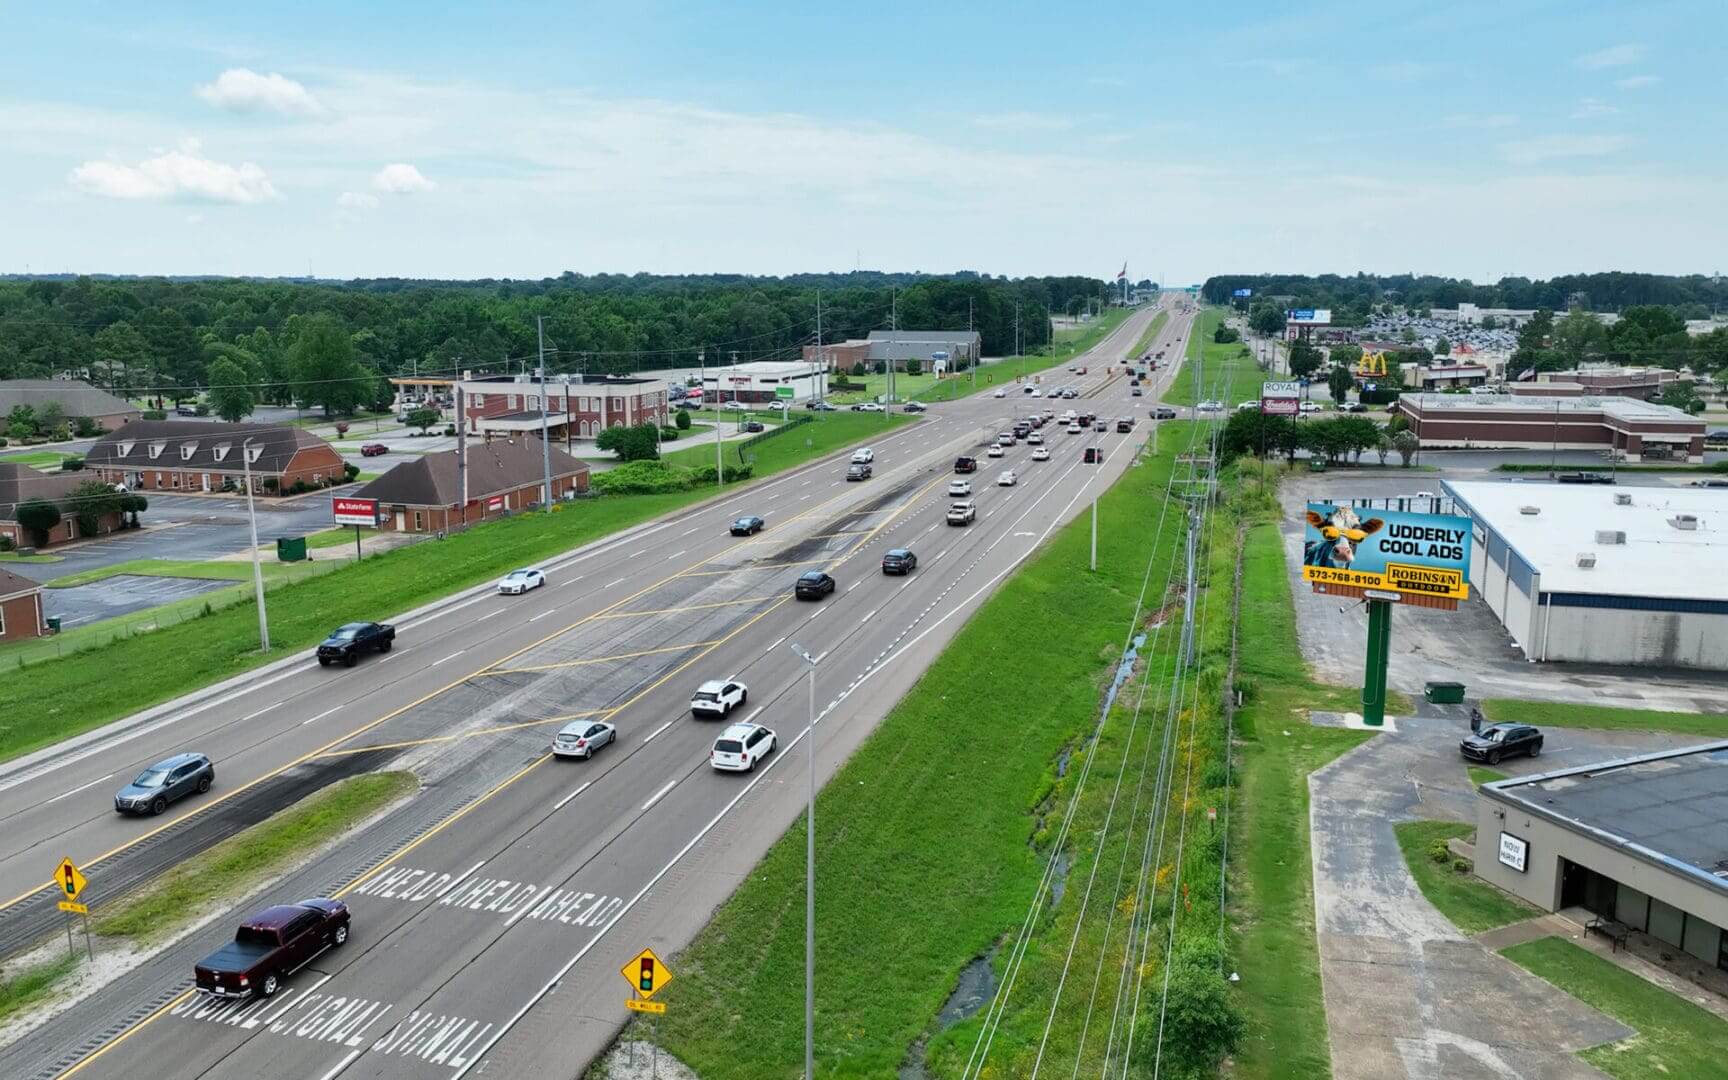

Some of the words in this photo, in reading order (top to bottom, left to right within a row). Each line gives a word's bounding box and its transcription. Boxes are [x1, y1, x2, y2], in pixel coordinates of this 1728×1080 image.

[1265, 383, 1297, 392] ROYAL
[1389, 524, 1465, 544] UDDERLY
[1379, 539, 1423, 556] COOL
[1427, 544, 1463, 560] ADS
[1309, 569, 1381, 586] 573-768-8100
[1392, 569, 1457, 585] ROBINSON
[1400, 582, 1446, 592] OUTDOOR
[353, 866, 451, 902] AHEAD
[439, 877, 537, 913] AHEAD
[526, 889, 623, 927] AHEAD
[269, 994, 393, 1047] SIGNAL
[372, 1010, 493, 1068] SIGNAL
